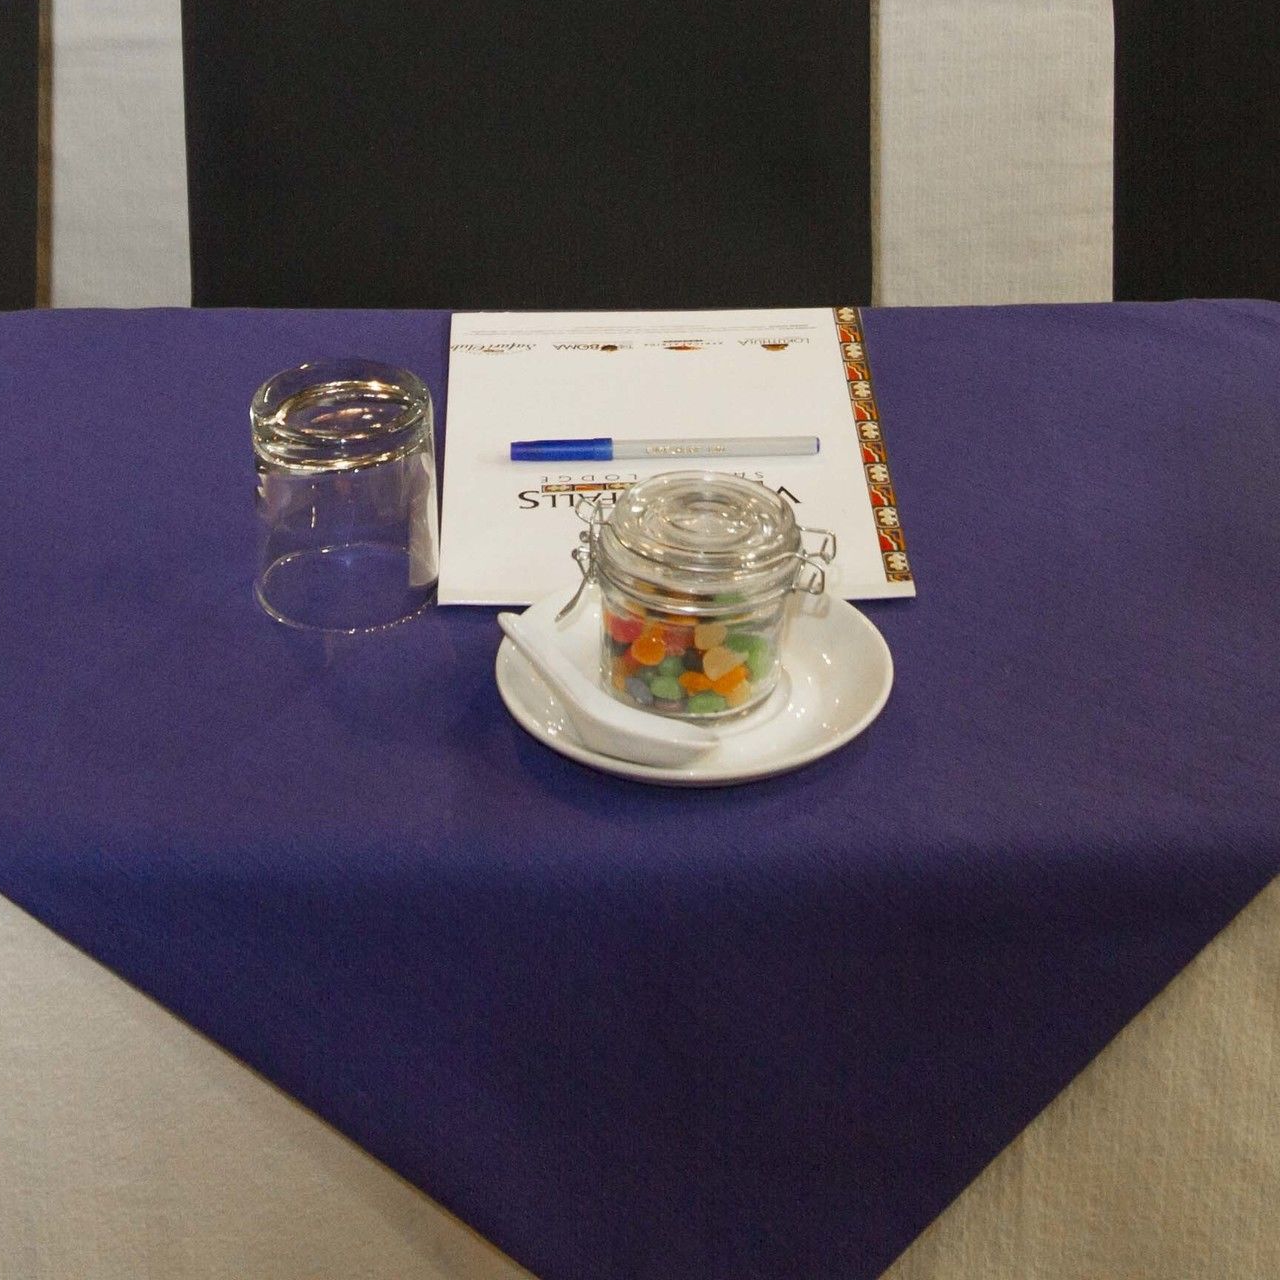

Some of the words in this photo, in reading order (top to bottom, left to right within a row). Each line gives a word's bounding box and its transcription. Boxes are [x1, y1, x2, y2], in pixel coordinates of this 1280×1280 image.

[488, 342, 537, 352] Safari
[553, 343, 600, 351] BOMA
[540, 475, 637, 483] LODGE
[517, 490, 617, 510] FALLS
